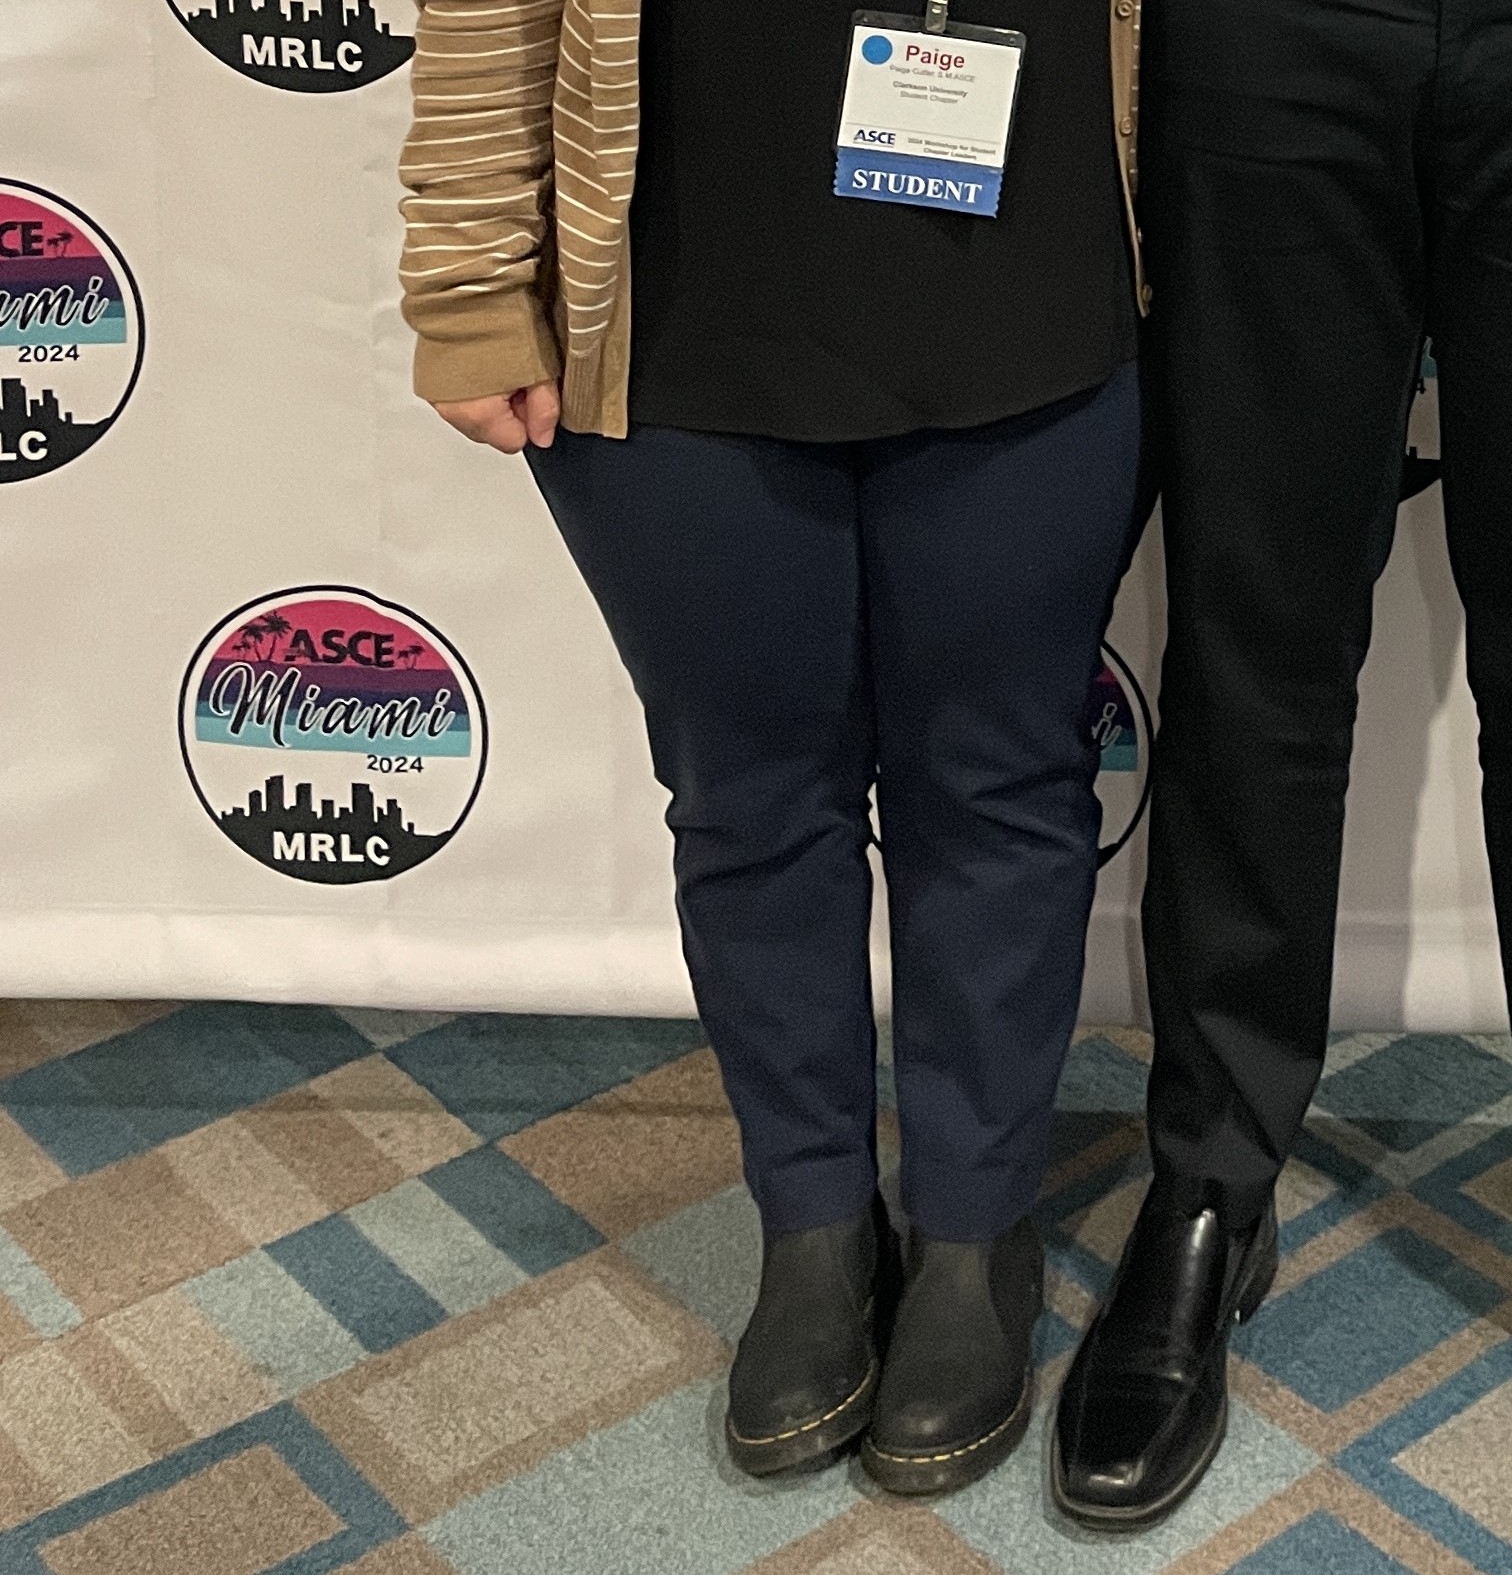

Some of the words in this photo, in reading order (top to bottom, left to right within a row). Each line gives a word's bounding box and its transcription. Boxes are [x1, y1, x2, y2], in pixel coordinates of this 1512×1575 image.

[242, 34, 365, 73] MRLC
[905, 45, 966, 72] Paige
[854, 129, 896, 145] ASCE
[852, 169, 983, 204] STUDENT
[0, 221, 44, 258] CE
[18, 345, 80, 363] 2024
[284, 628, 395, 668] ASCE
[208, 664, 456, 749] Miami
[367, 753, 424, 775] 2024
[273, 833, 390, 867] MRLC
